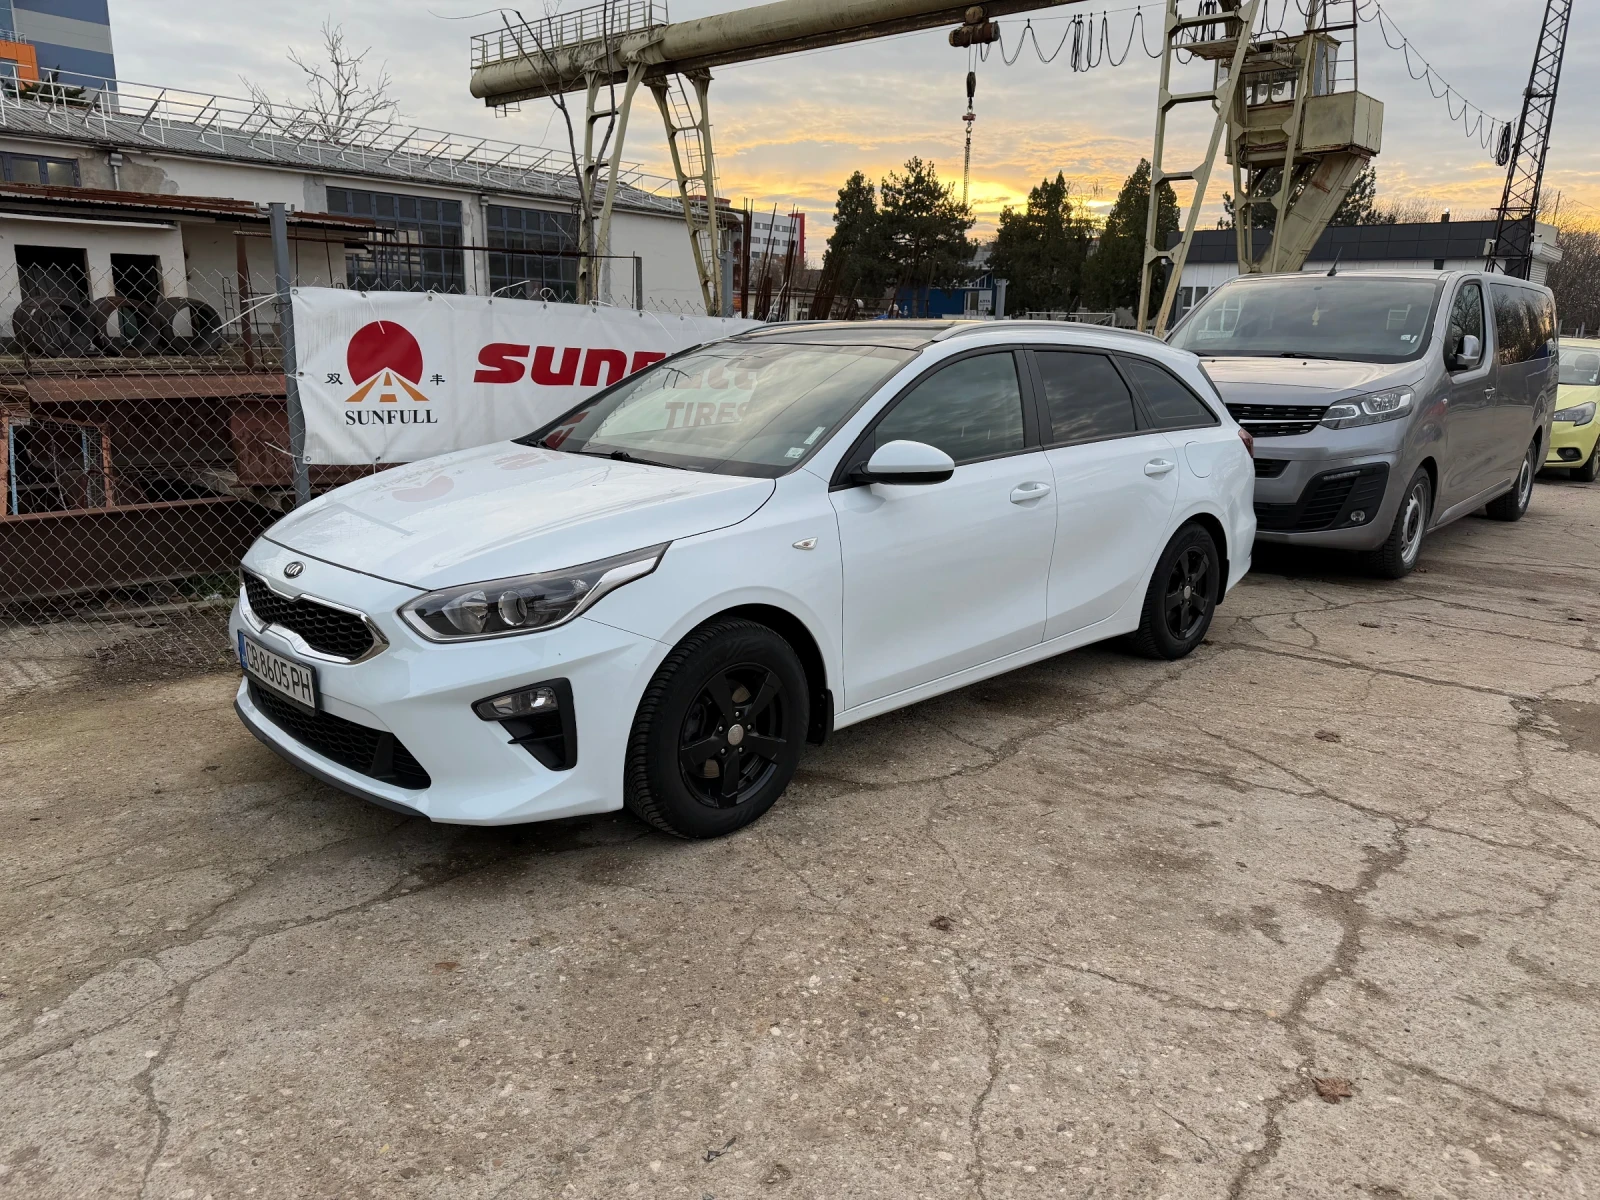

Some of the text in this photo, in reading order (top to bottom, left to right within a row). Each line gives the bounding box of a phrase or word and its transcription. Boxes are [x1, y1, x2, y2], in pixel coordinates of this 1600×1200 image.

[325, 373, 445, 385] 双 丰
[345, 409, 438, 425] SUNFULL
